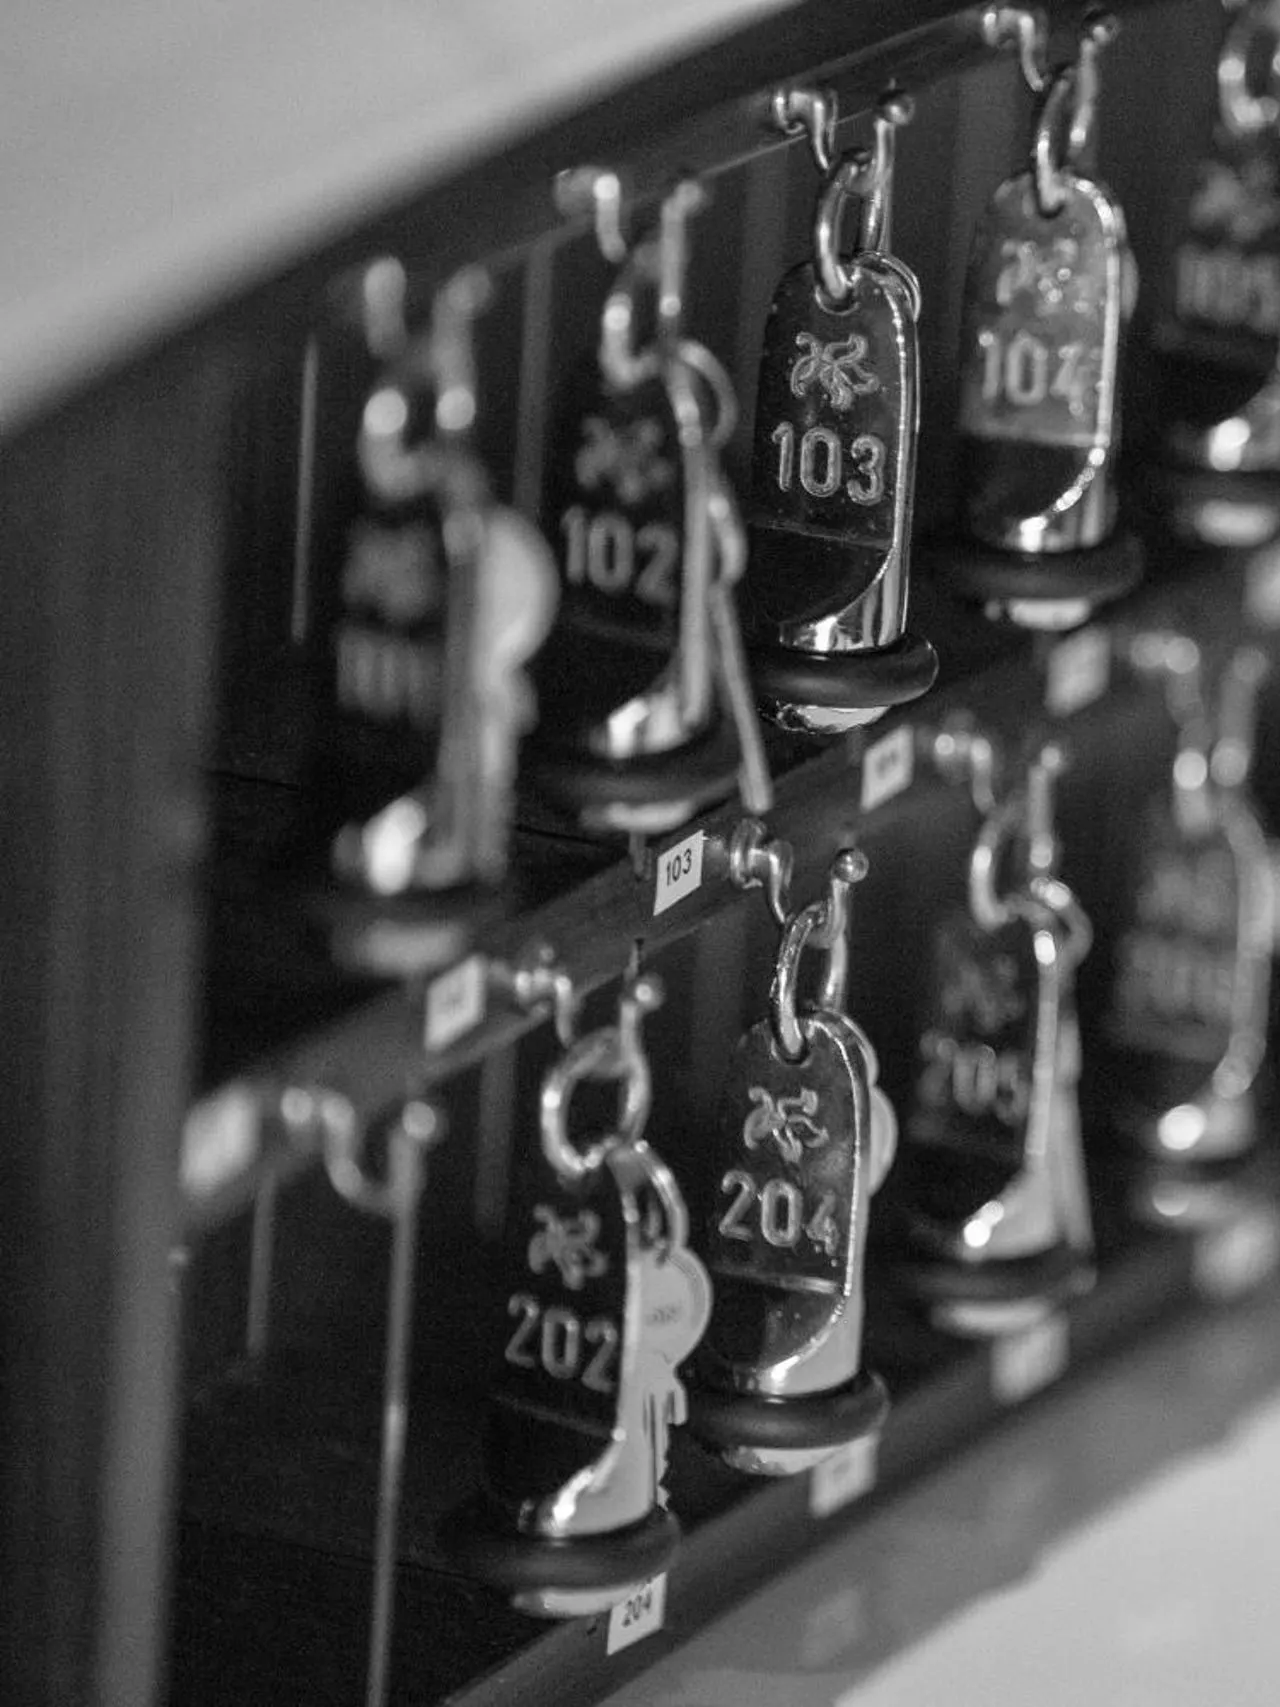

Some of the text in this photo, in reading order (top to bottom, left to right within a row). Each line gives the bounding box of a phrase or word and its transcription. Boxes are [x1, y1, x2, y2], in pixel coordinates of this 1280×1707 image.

[979, 328, 1086, 419] 104
[771, 421, 885, 506] 103
[562, 505, 679, 602] 102
[666, 848, 692, 887] 103
[718, 1169, 840, 1256] 204
[504, 1293, 619, 1392] 202
[621, 1591, 652, 1628] 204
